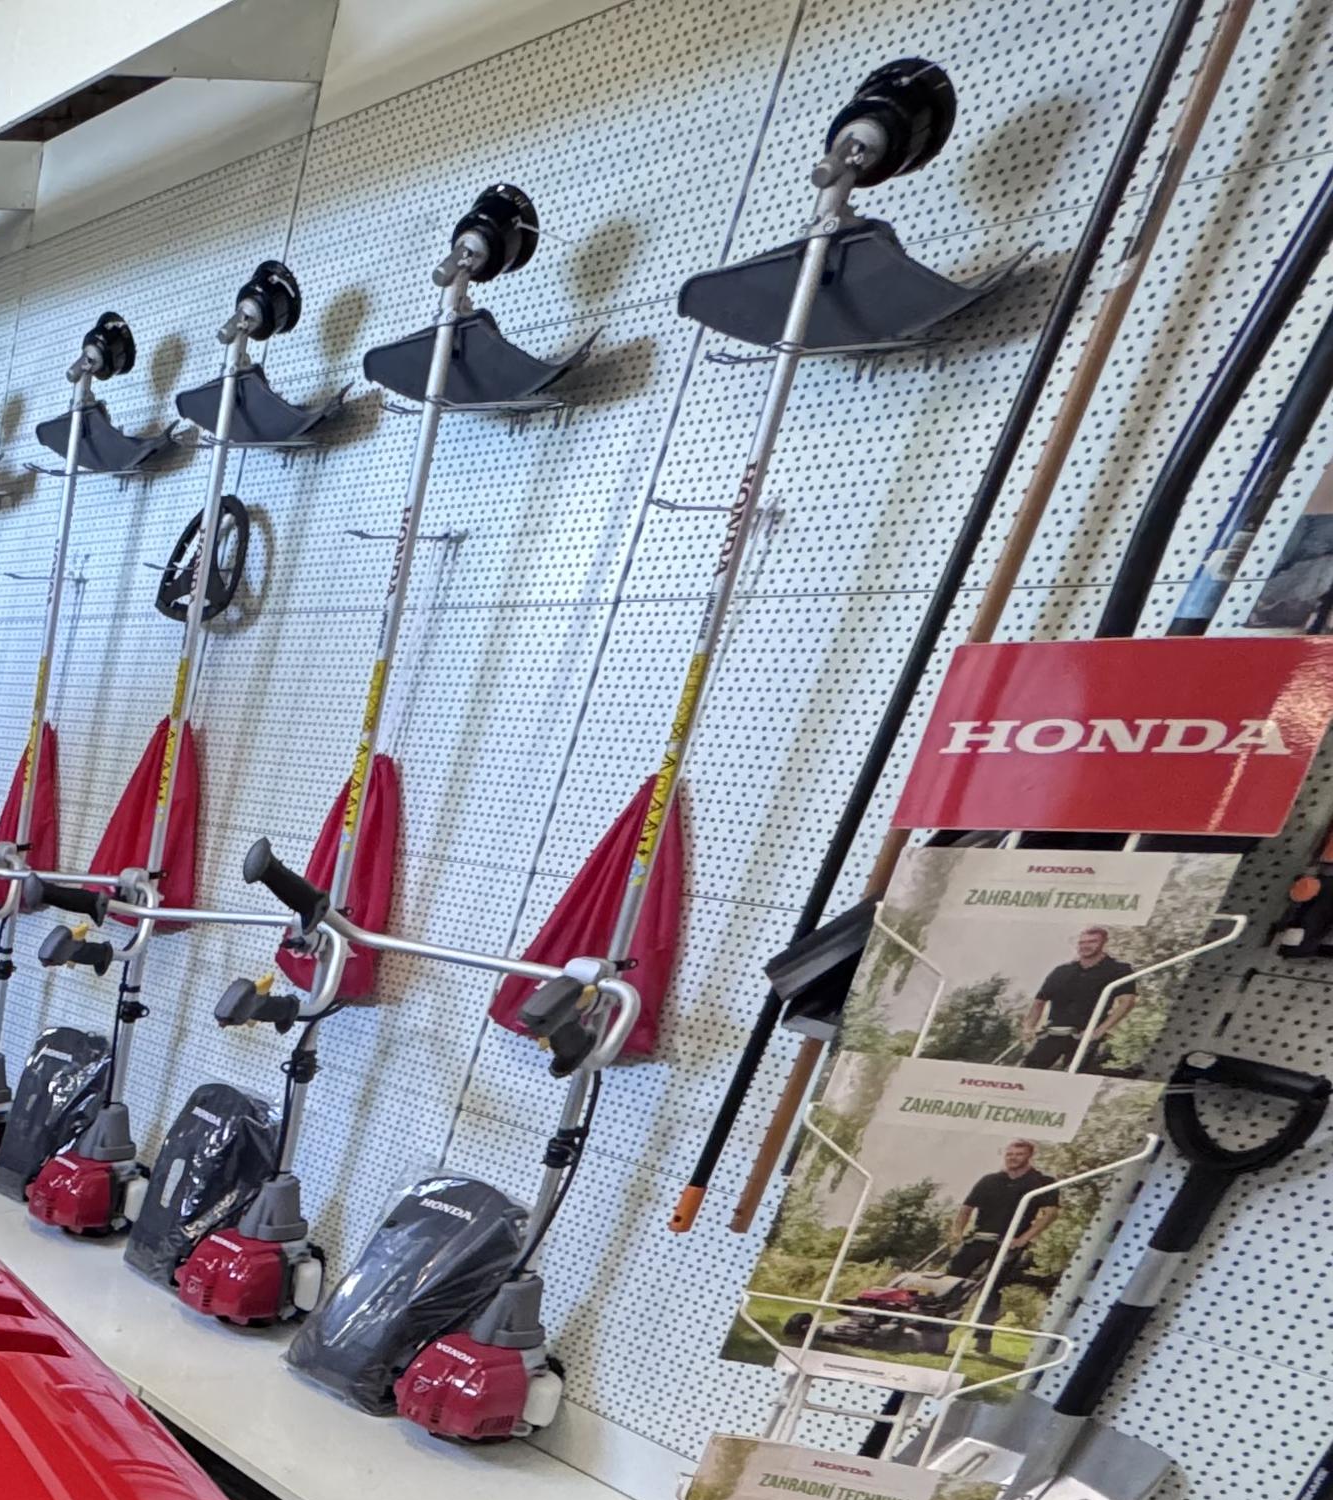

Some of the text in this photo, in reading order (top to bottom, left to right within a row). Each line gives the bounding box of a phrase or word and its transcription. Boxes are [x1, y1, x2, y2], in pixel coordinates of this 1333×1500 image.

[713, 461, 758, 578] HONDA
[939, 718, 1293, 757] HONDA
[1026, 864, 1096, 876] HONDA
[963, 887, 1142, 912] ZAHRADNÍ TECHNIKA
[959, 1077, 1026, 1091] HONDA
[899, 1096, 1068, 1129] ZAHRADNÍ TECHNIKA
[419, 1198, 474, 1222] HONDA
[435, 1342, 477, 1366] HONDA
[811, 1460, 874, 1478] HONDA
